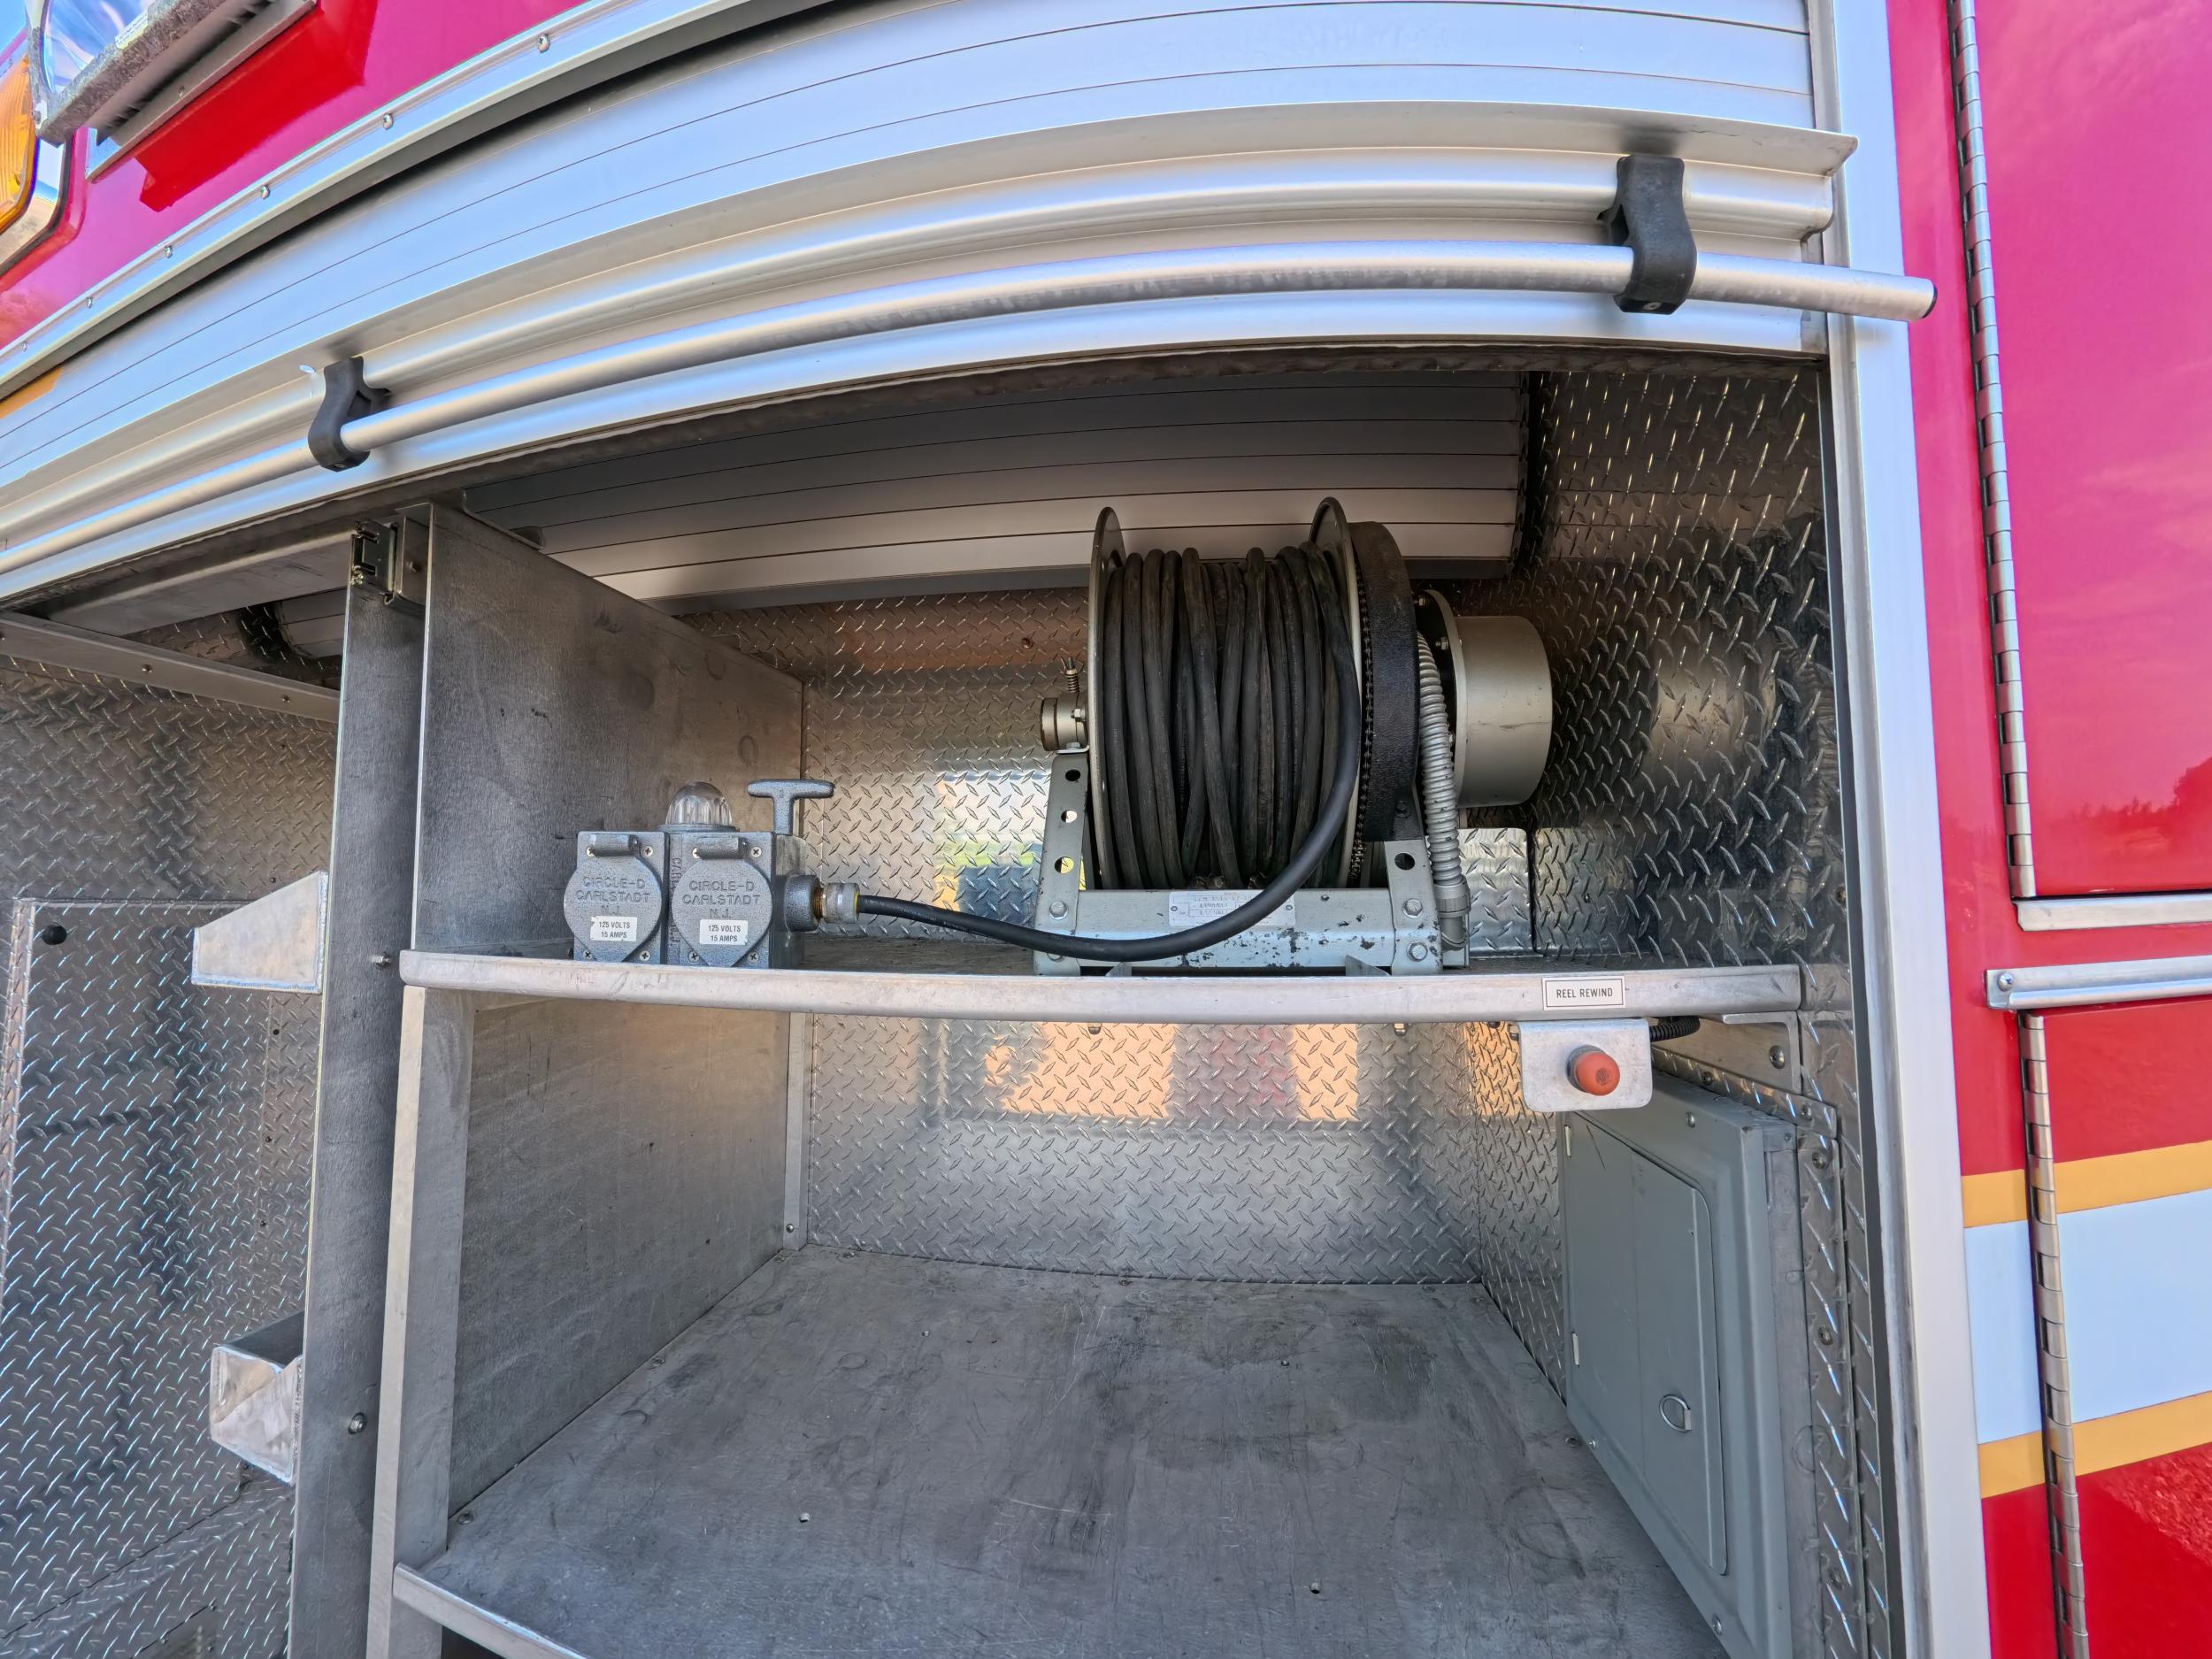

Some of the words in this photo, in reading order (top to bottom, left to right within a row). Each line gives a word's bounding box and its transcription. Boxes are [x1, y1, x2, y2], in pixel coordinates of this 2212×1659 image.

[582, 876, 646, 889] CIRCLE-D
[688, 880, 755, 892] CIRCLE-D
[575, 889, 650, 902] CARLSTADT
[682, 894, 761, 905] CARLSTADT
[1556, 988, 1577, 999] REEL
[1579, 987, 1613, 998] REWIND
